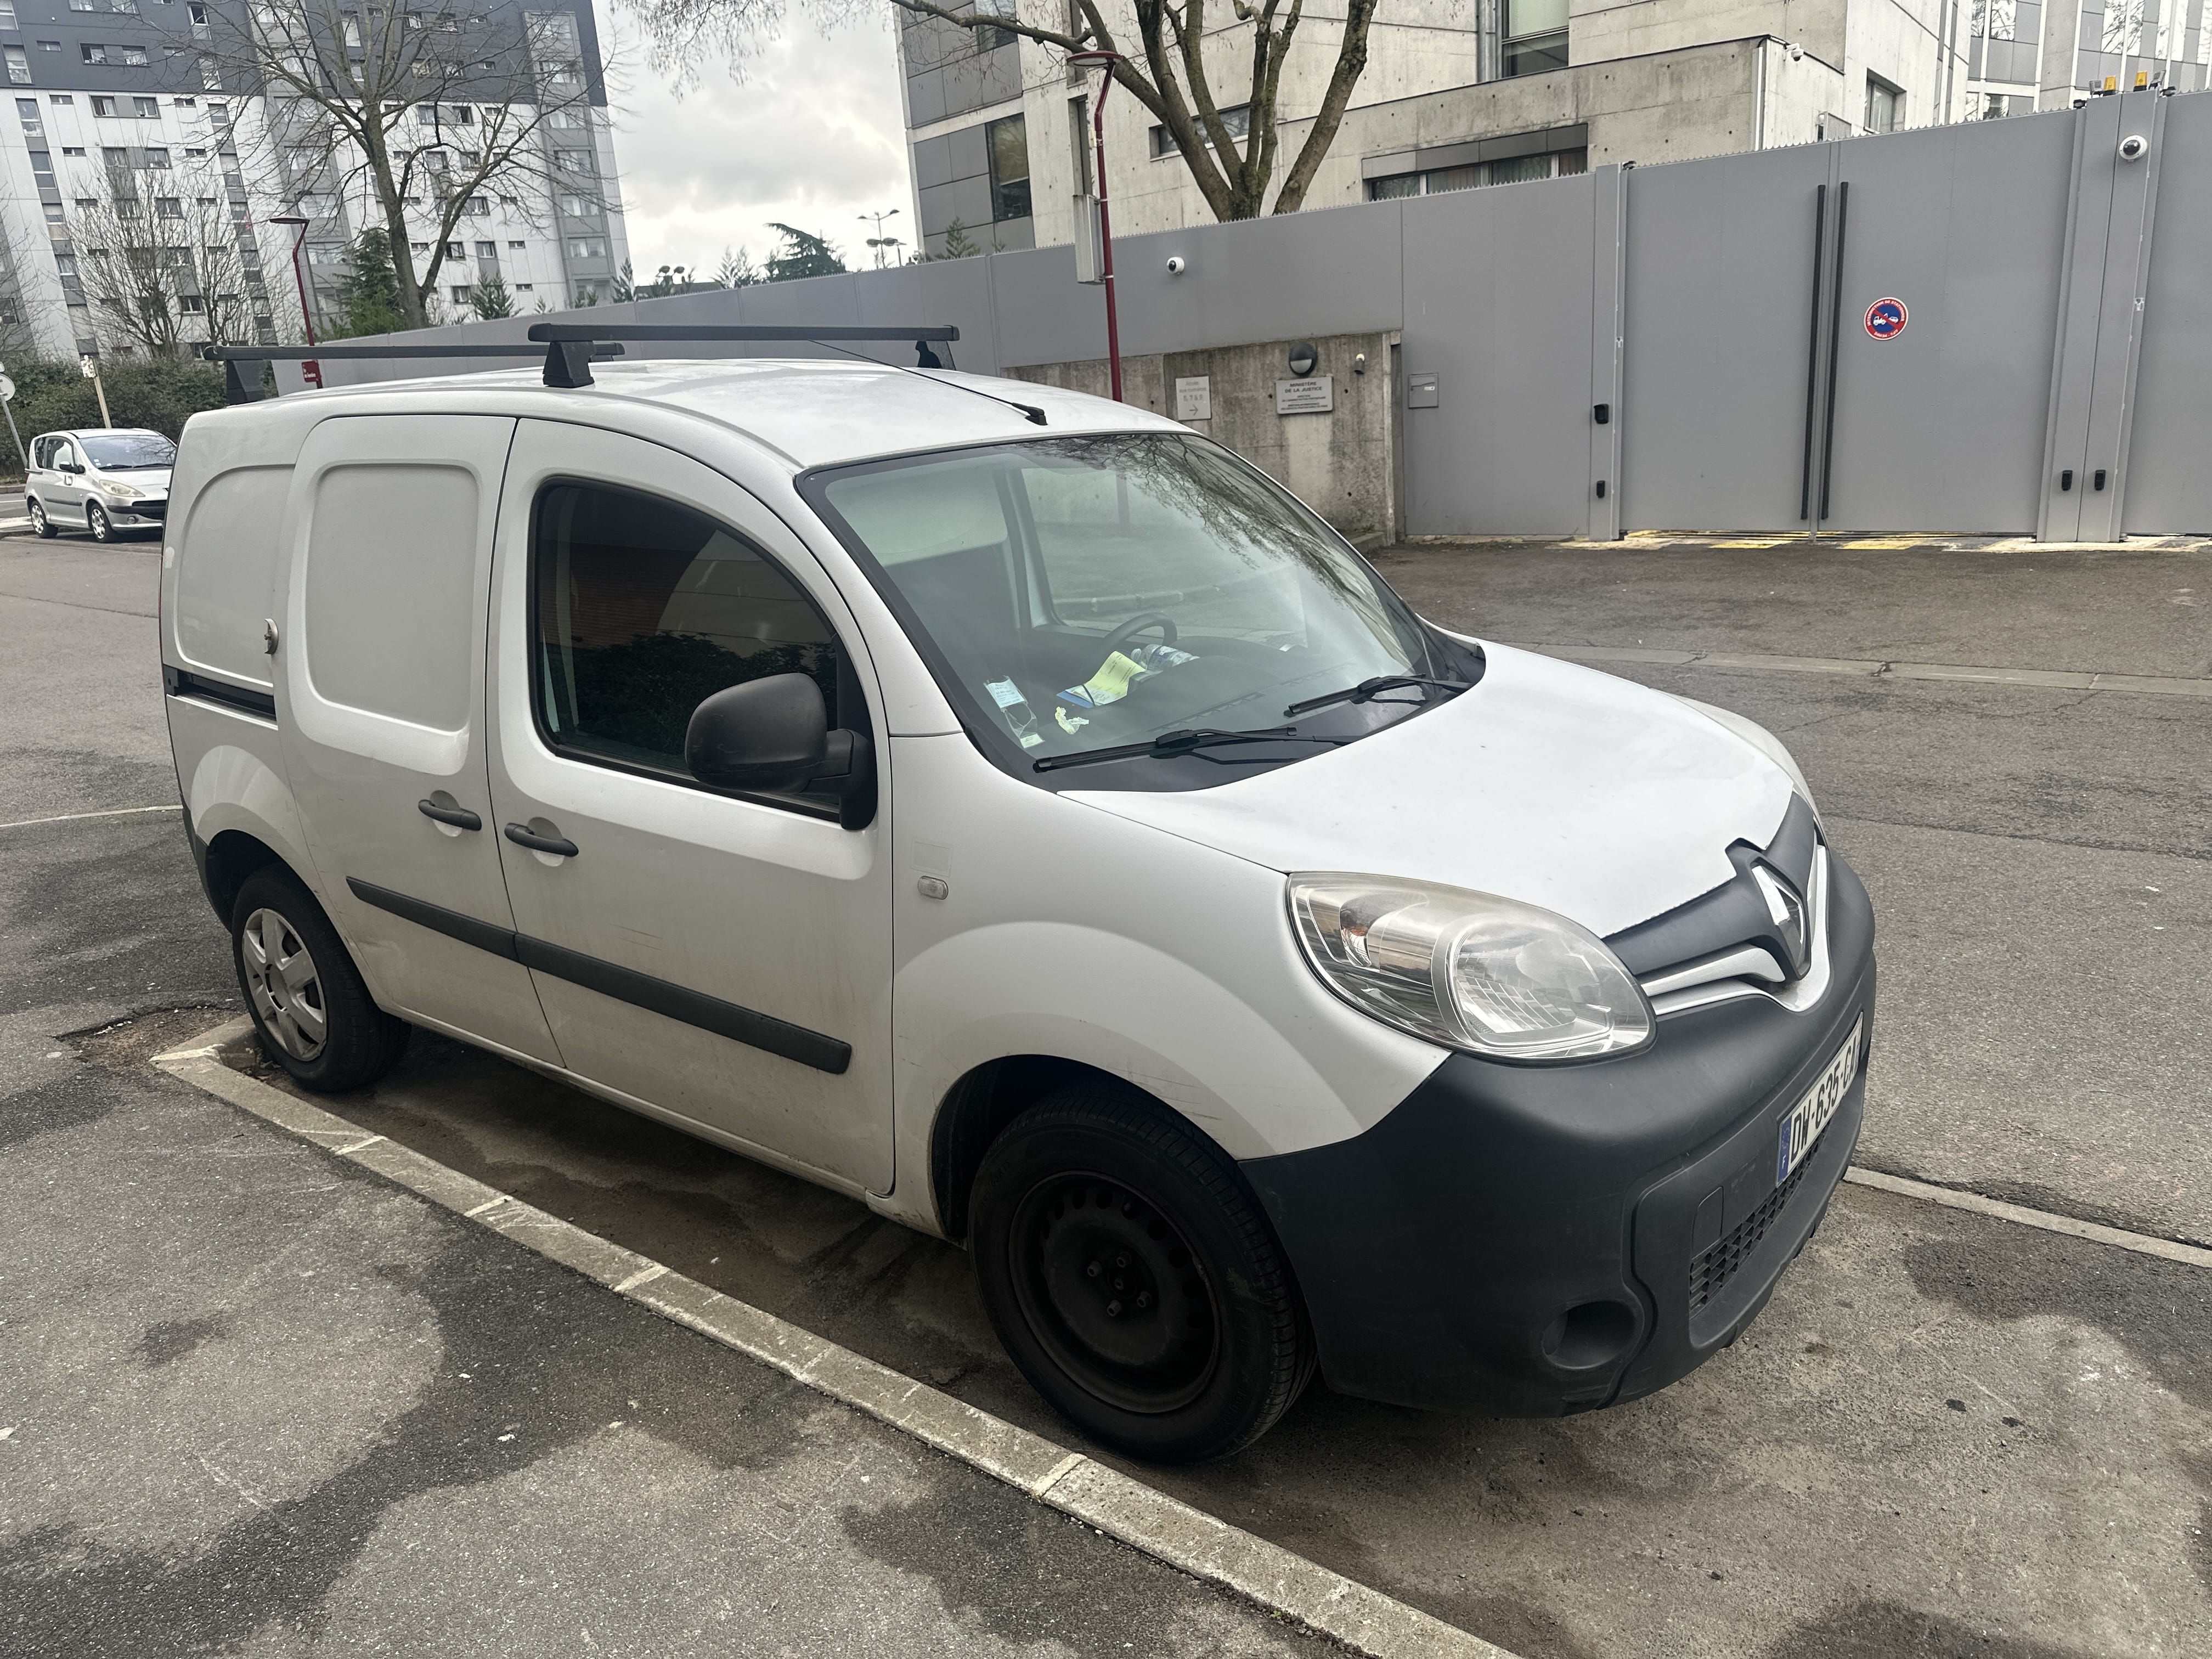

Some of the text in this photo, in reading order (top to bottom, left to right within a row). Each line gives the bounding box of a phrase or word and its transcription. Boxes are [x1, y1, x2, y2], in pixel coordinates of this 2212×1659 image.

[1867, 301, 1884, 326] INTERDICTION
[1891, 301, 1905, 321] STATIONNER
[1782, 1154, 1786, 1169] F
